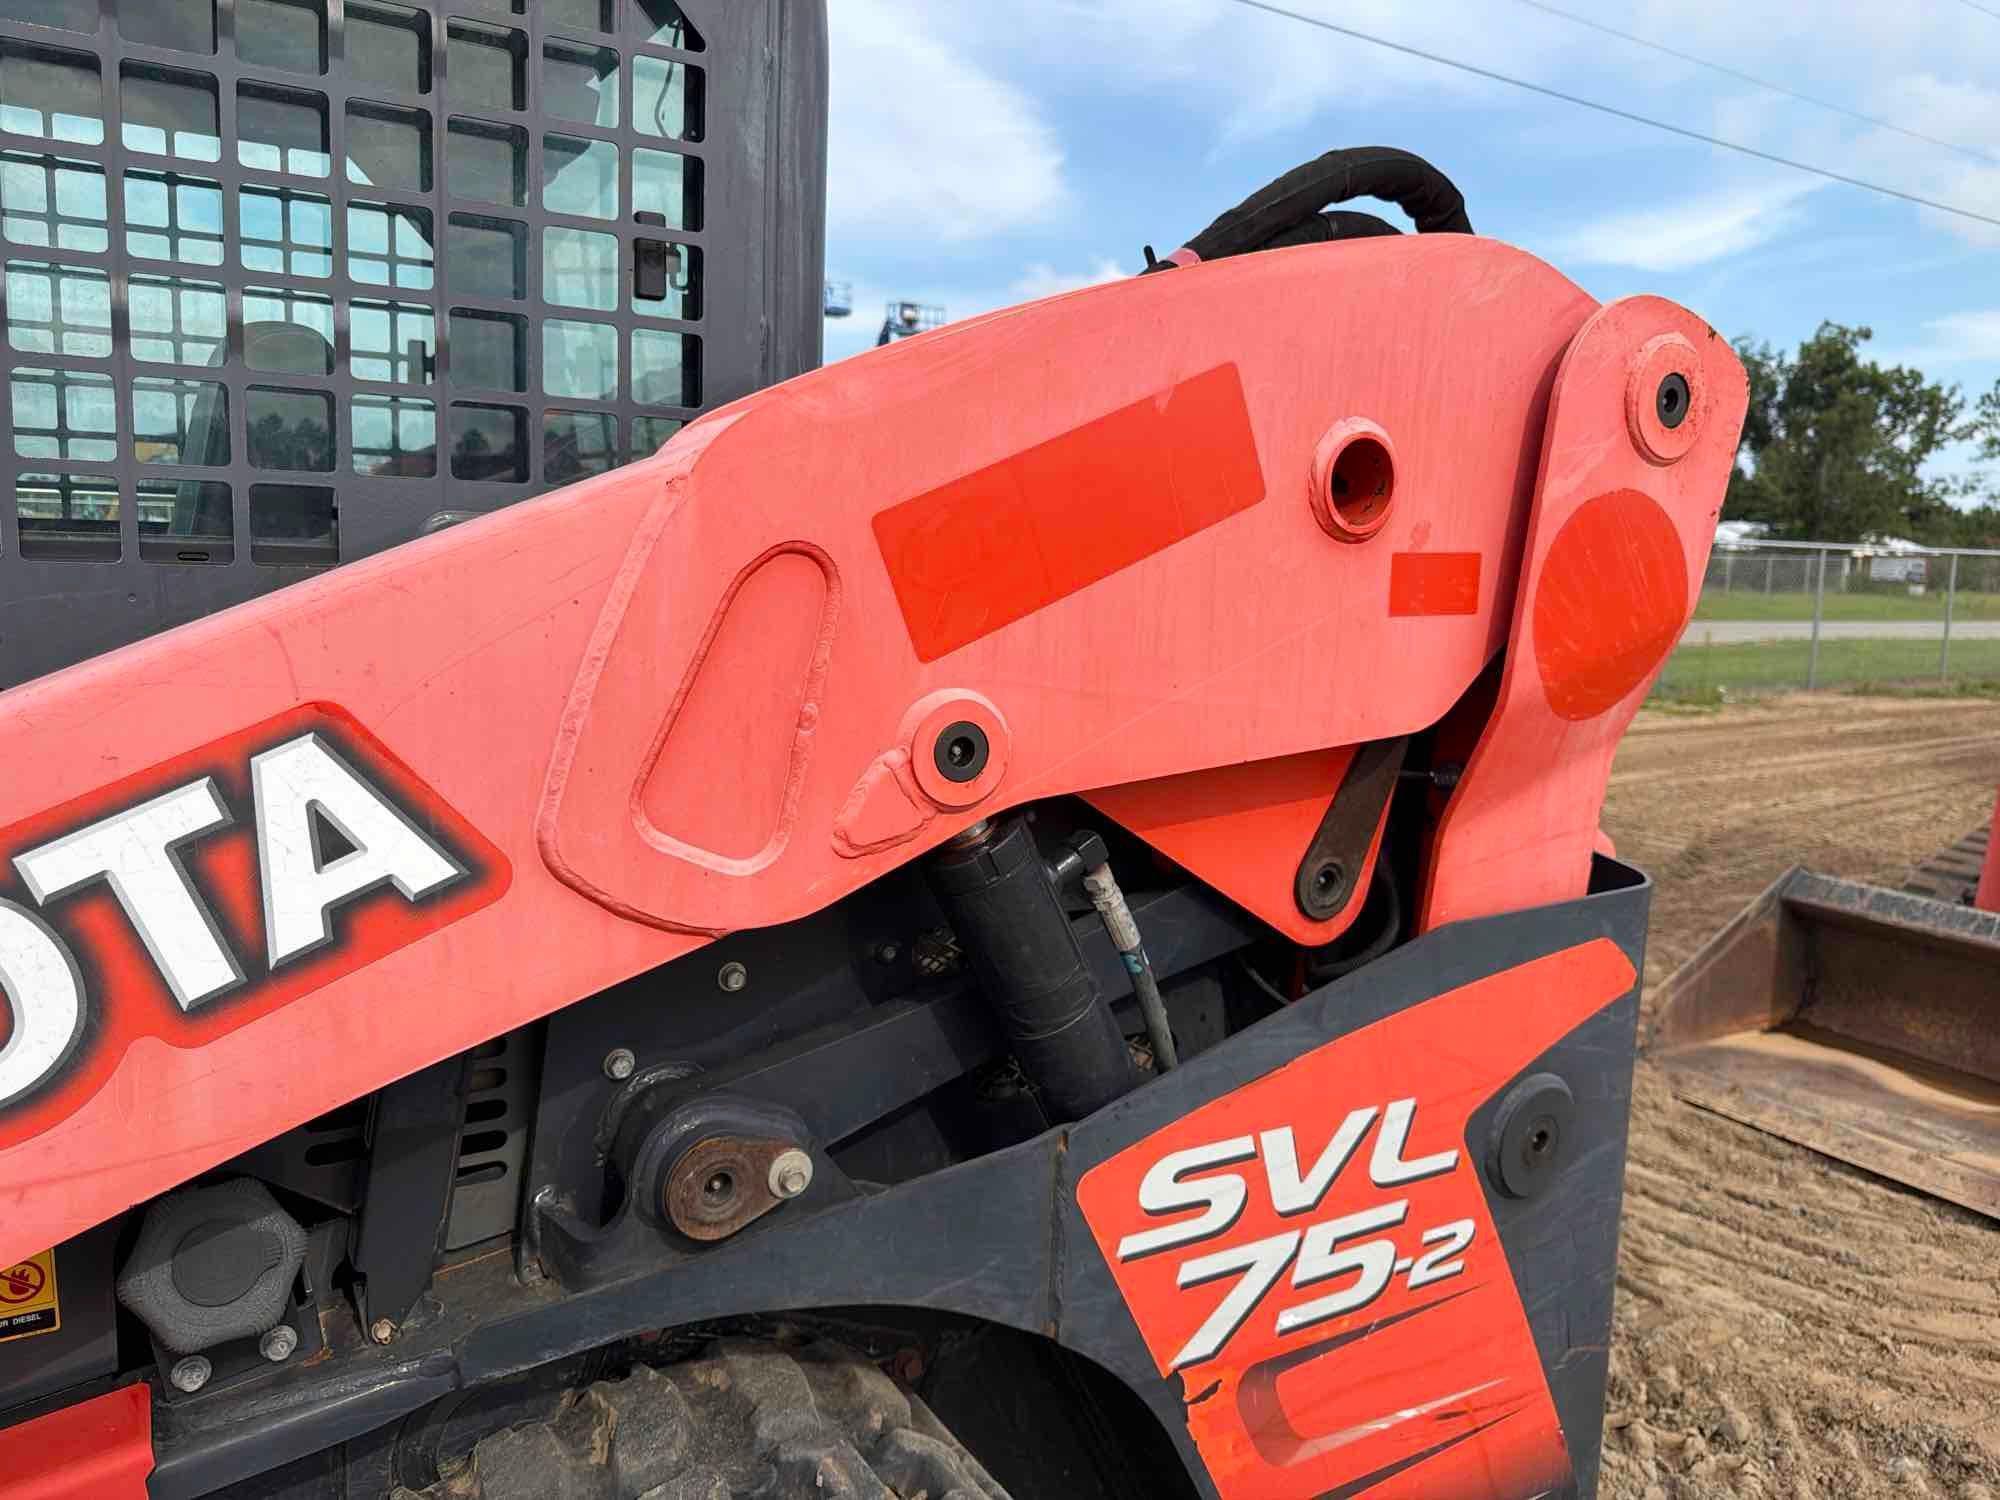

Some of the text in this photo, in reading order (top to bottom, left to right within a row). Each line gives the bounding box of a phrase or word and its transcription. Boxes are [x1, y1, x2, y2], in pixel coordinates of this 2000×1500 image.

[1116, 1097, 1460, 1263] SVL
[13, 1313, 41, 1324] DIESEL
[1167, 1199, 1476, 1370] 75-2
